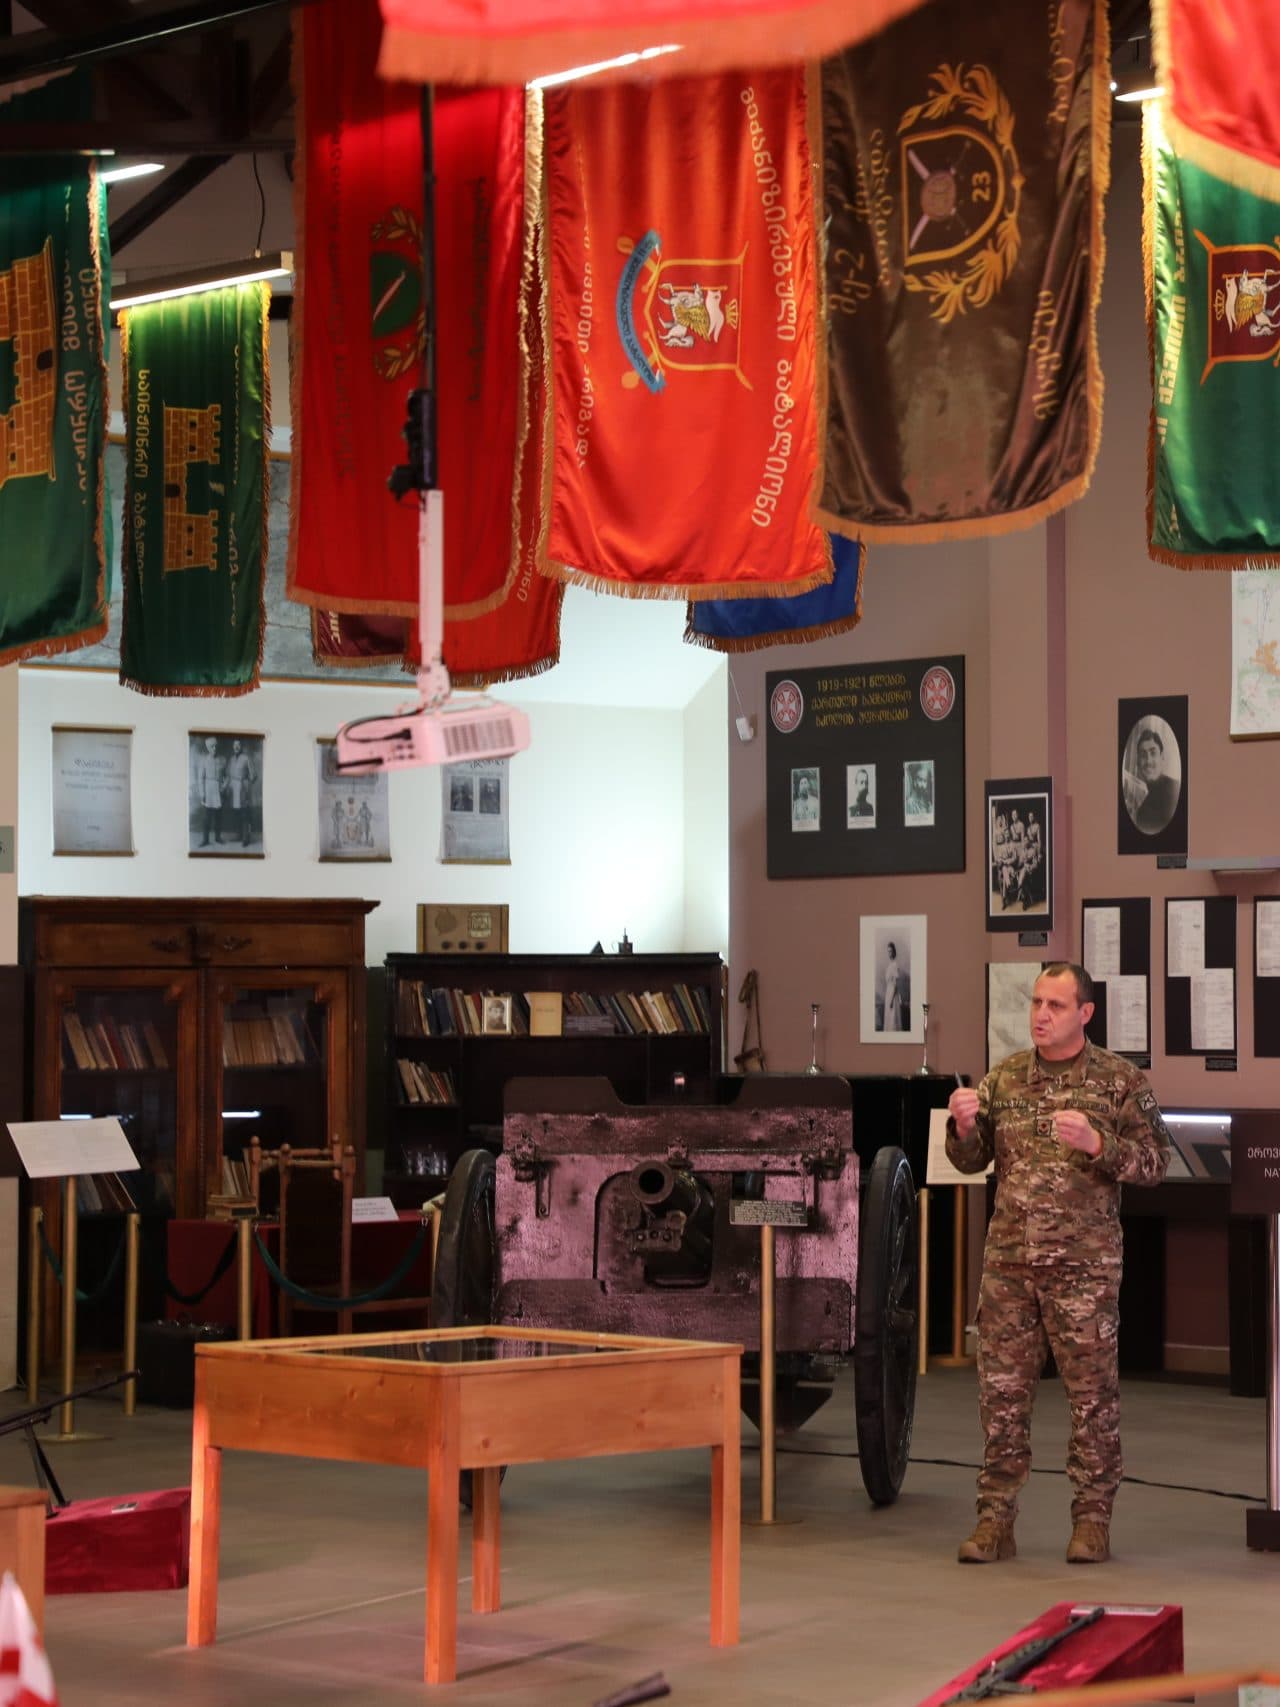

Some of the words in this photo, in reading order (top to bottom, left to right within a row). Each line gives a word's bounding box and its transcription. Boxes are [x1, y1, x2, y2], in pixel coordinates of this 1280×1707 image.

[740, 88, 797, 340] მექანიზირებული
[971, 171, 991, 201] 23
[134, 368, 151, 477] საინჟინრო
[751, 359, 797, 528] ბატალიონი
